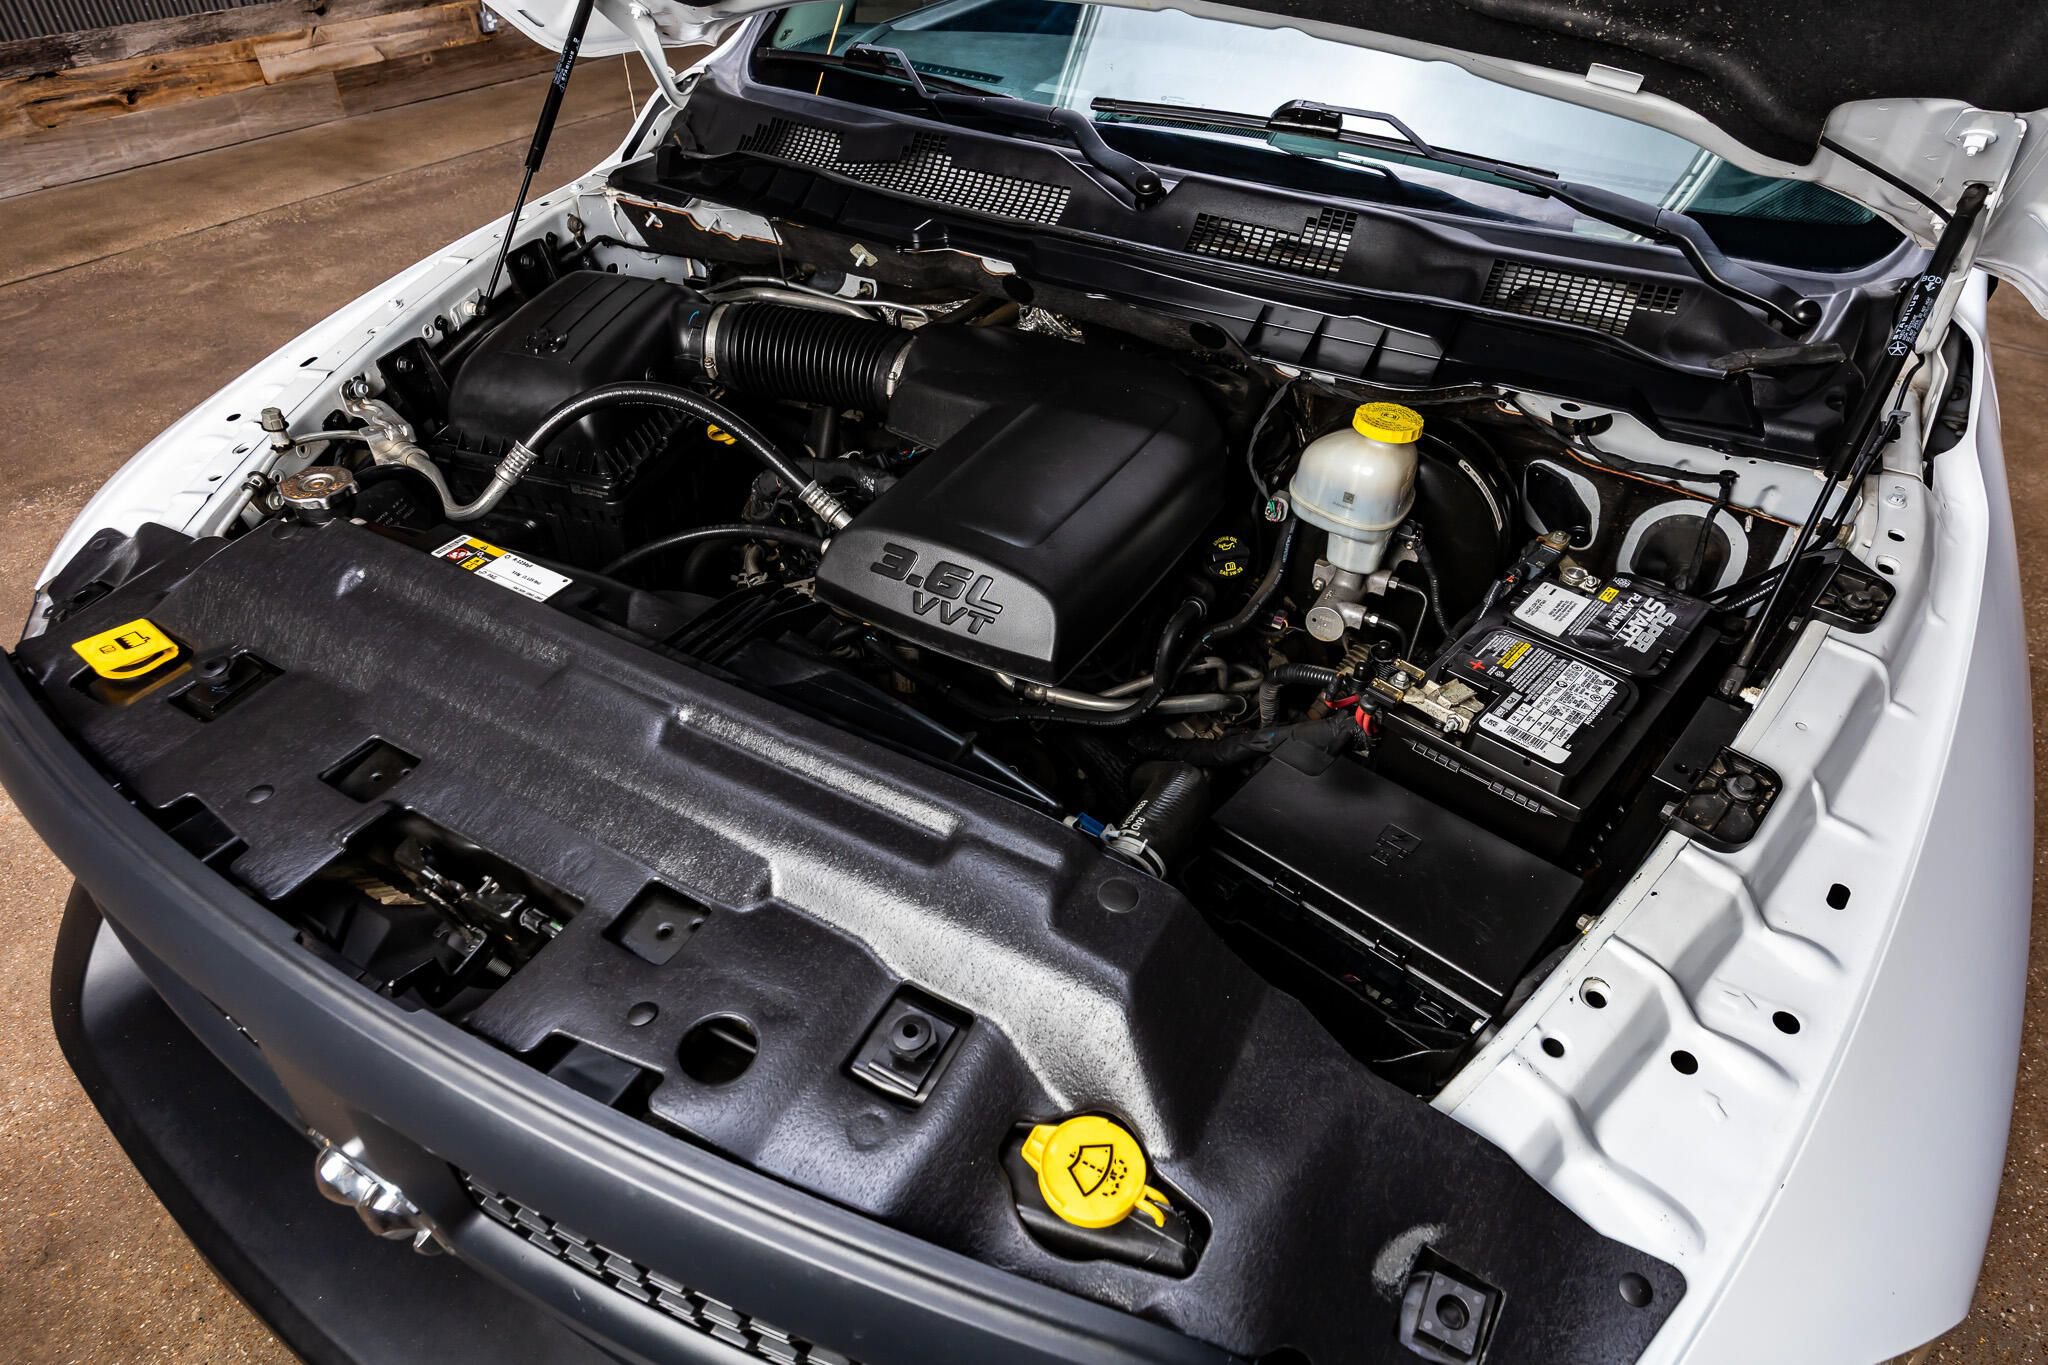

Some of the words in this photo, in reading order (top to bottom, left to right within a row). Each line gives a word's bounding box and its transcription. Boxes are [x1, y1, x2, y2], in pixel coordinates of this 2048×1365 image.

[1893, 294, 1920, 341] STABILUS
[870, 542, 1003, 614] 3.6L
[913, 590, 995, 634] VVT
[1605, 592, 1643, 630] PLATINUM
[1623, 597, 1667, 649] START
[1635, 610, 1678, 653] SUPER
[1130, 816, 1146, 831] RAD
